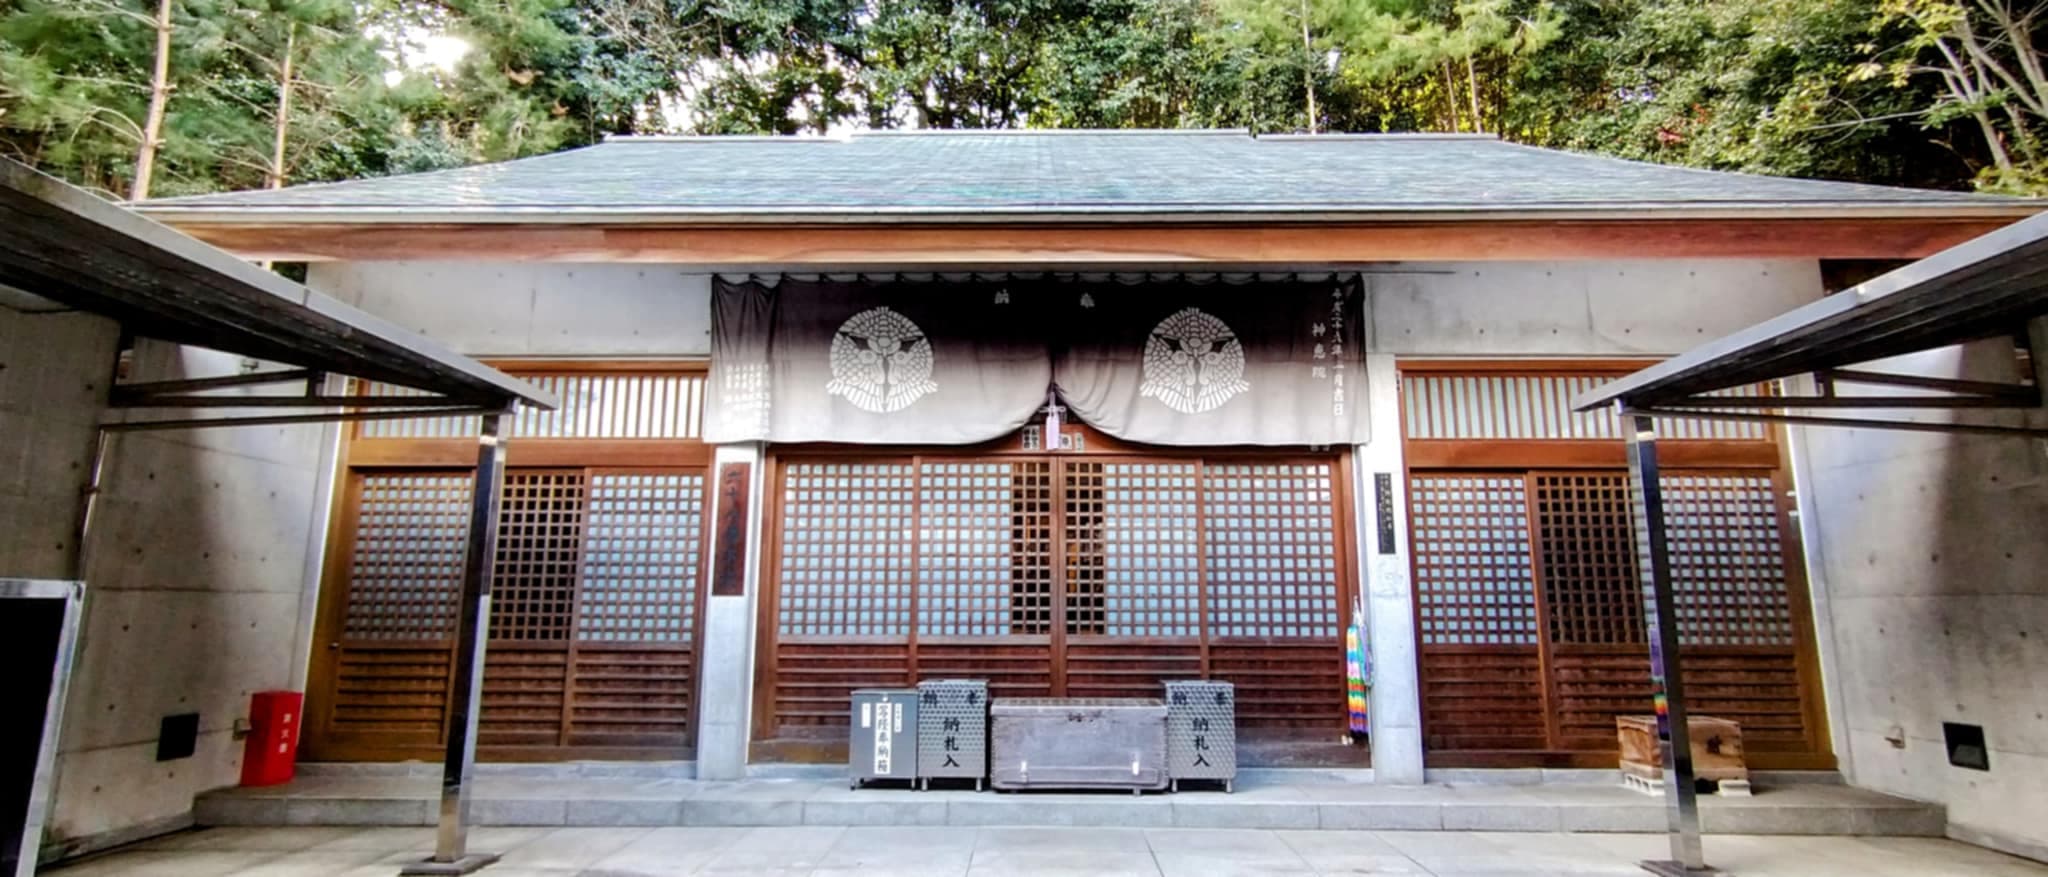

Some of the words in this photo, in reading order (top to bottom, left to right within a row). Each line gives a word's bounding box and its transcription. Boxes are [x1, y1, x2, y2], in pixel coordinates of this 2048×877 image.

[942, 717, 960, 768] 納札入
[1192, 717, 1211, 767] 納札入
